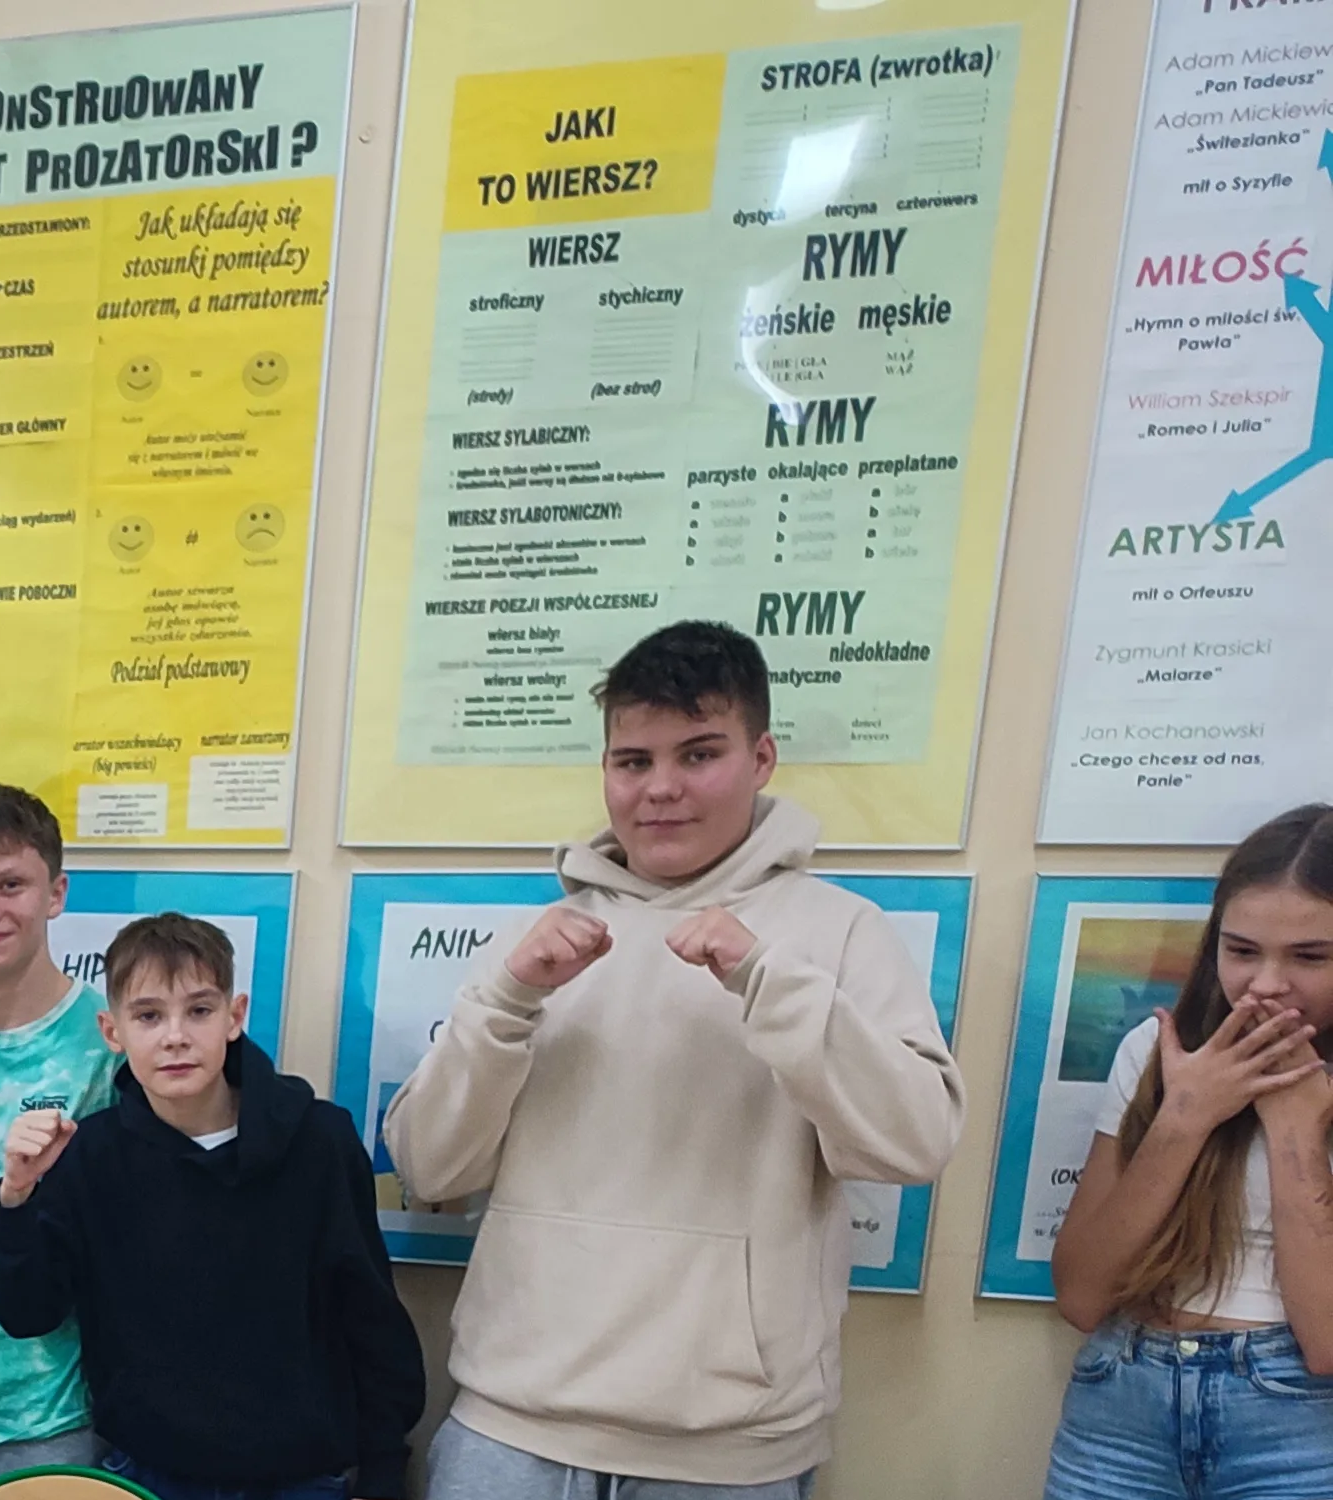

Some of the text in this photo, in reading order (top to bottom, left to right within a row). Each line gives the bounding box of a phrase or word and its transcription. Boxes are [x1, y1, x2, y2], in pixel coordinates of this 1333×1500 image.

[760, 44, 993, 92] STROFA (zwrotka)
[1165, 51, 1235, 73] Adam
[545, 106, 617, 145] JAKI
[1154, 109, 1224, 131] Adam
[26, 121, 280, 193] PROZATORSKI
[478, 159, 659, 207] TO WIERSZ?
[1183, 173, 1293, 196] mit o Syzyfie
[135, 197, 302, 241] Jak układają się
[825, 200, 878, 220] tercyna
[896, 193, 979, 212] czterowers
[122, 238, 310, 281] stosunki pomiędzy
[528, 231, 621, 268] WIERSZ
[802, 227, 908, 281] RYMY
[1135, 237, 1309, 288] MIŁOŚĆ
[96, 281, 330, 320] autorem, a narratorem?
[469, 286, 684, 313] stroficzny stychiczny
[858, 294, 952, 336] męskie
[1189, 315, 1201, 328] o
[1205, 310, 1269, 328] miłości
[765, 396, 877, 449] RYMY
[1212, 420, 1218, 434] i
[452, 425, 591, 450] WIERSZ SYLABICZNY:
[687, 464, 757, 488] parzyste
[768, 460, 849, 482] okalające
[858, 454, 959, 478] przeplatane
[448, 508, 497, 527] WIERSZ
[1107, 519, 1285, 559] ARTYSTA
[425, 592, 659, 616] WIERSZE POEZJI WSPÓŁCZESNEJ
[1131, 584, 1254, 602] mit o Orfeuszu
[755, 590, 866, 636] RYMY
[488, 627, 526, 641] wiersz
[1095, 639, 1273, 665] Zygmunt Krasicki
[111, 652, 251, 688] Podział podstawowy
[483, 673, 523, 687] wiersz
[767, 668, 842, 688] matyczne
[1080, 721, 1265, 742] Jan Kochanowski
[1138, 751, 1198, 766] chcesz
[1202, 751, 1227, 766] od
[63, 952, 107, 984] HIP
[1051, 1167, 1085, 1186] (OK
